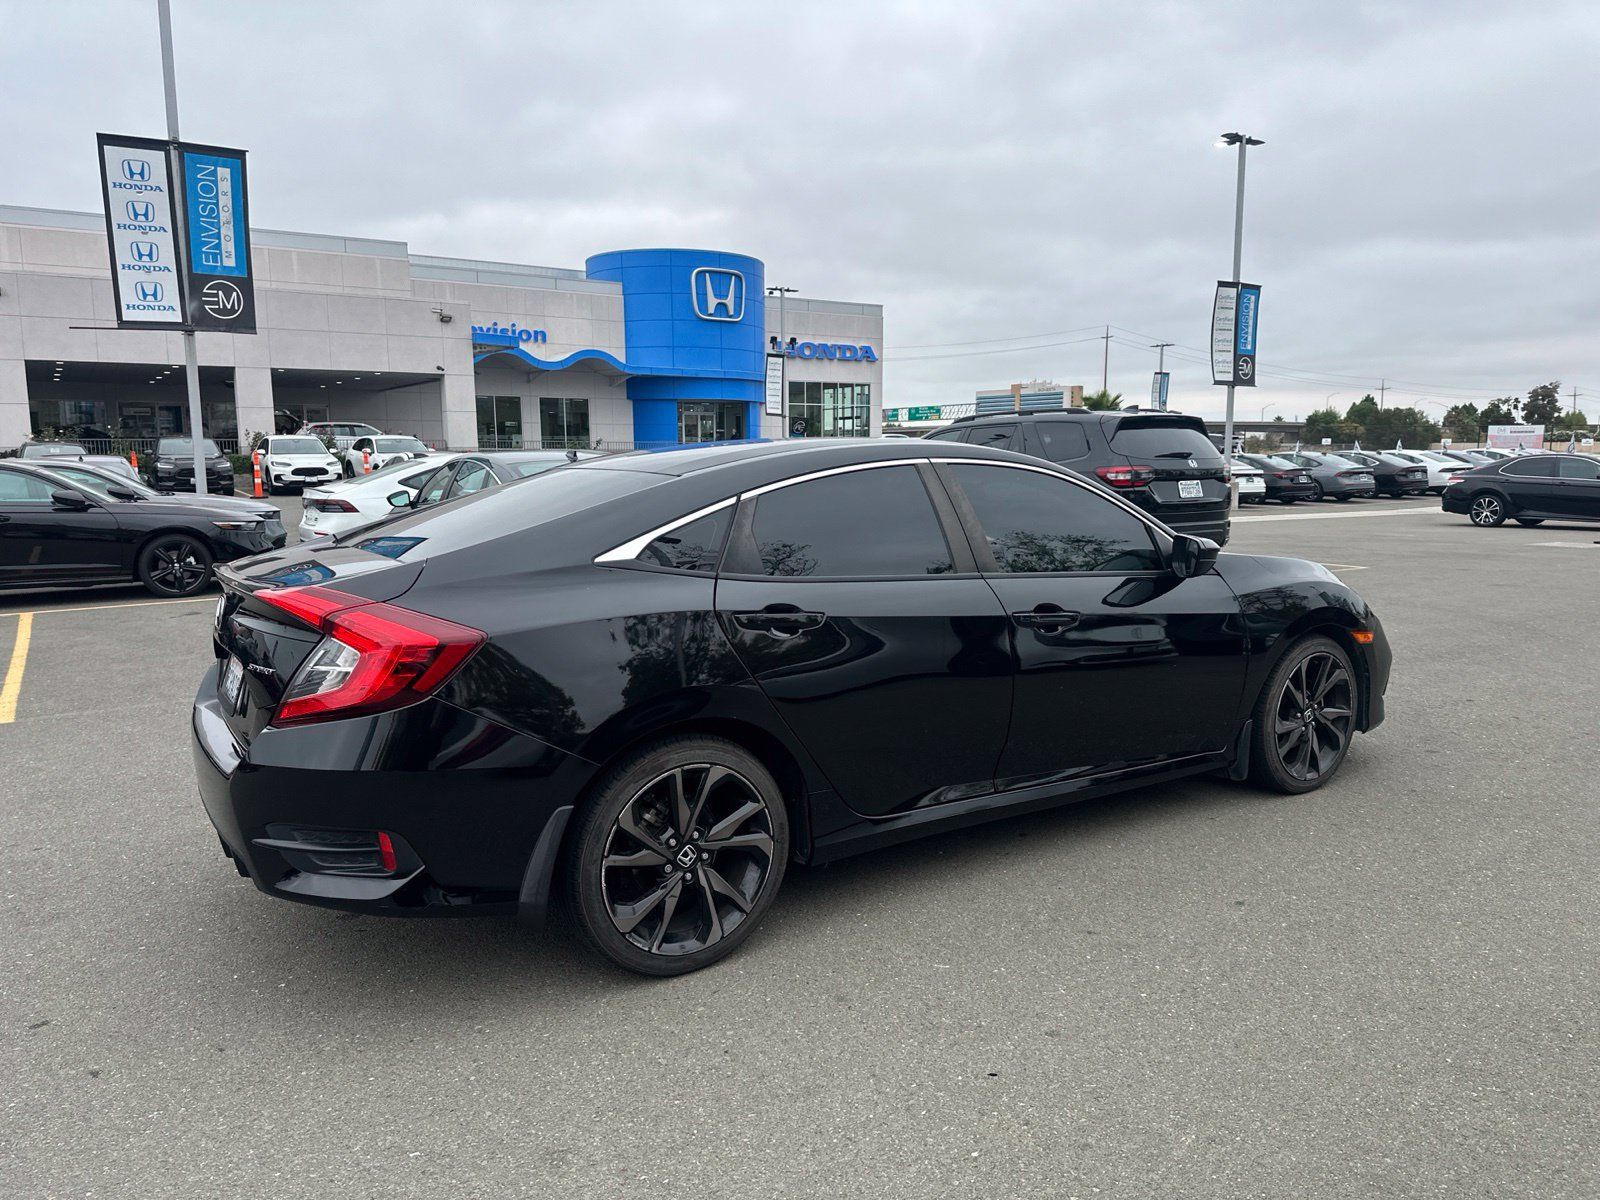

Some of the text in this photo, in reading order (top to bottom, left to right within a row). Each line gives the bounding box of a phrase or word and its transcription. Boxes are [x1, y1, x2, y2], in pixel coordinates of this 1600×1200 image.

[112, 181, 164, 192] HONDA
[196, 164, 221, 267] ENVISION
[220, 176, 233, 259] MOTORS
[116, 223, 169, 233] HONDA
[120, 263, 172, 273] HONDA
[125, 303, 176, 312] HONDA
[1240, 294, 1252, 350] ENVISION
